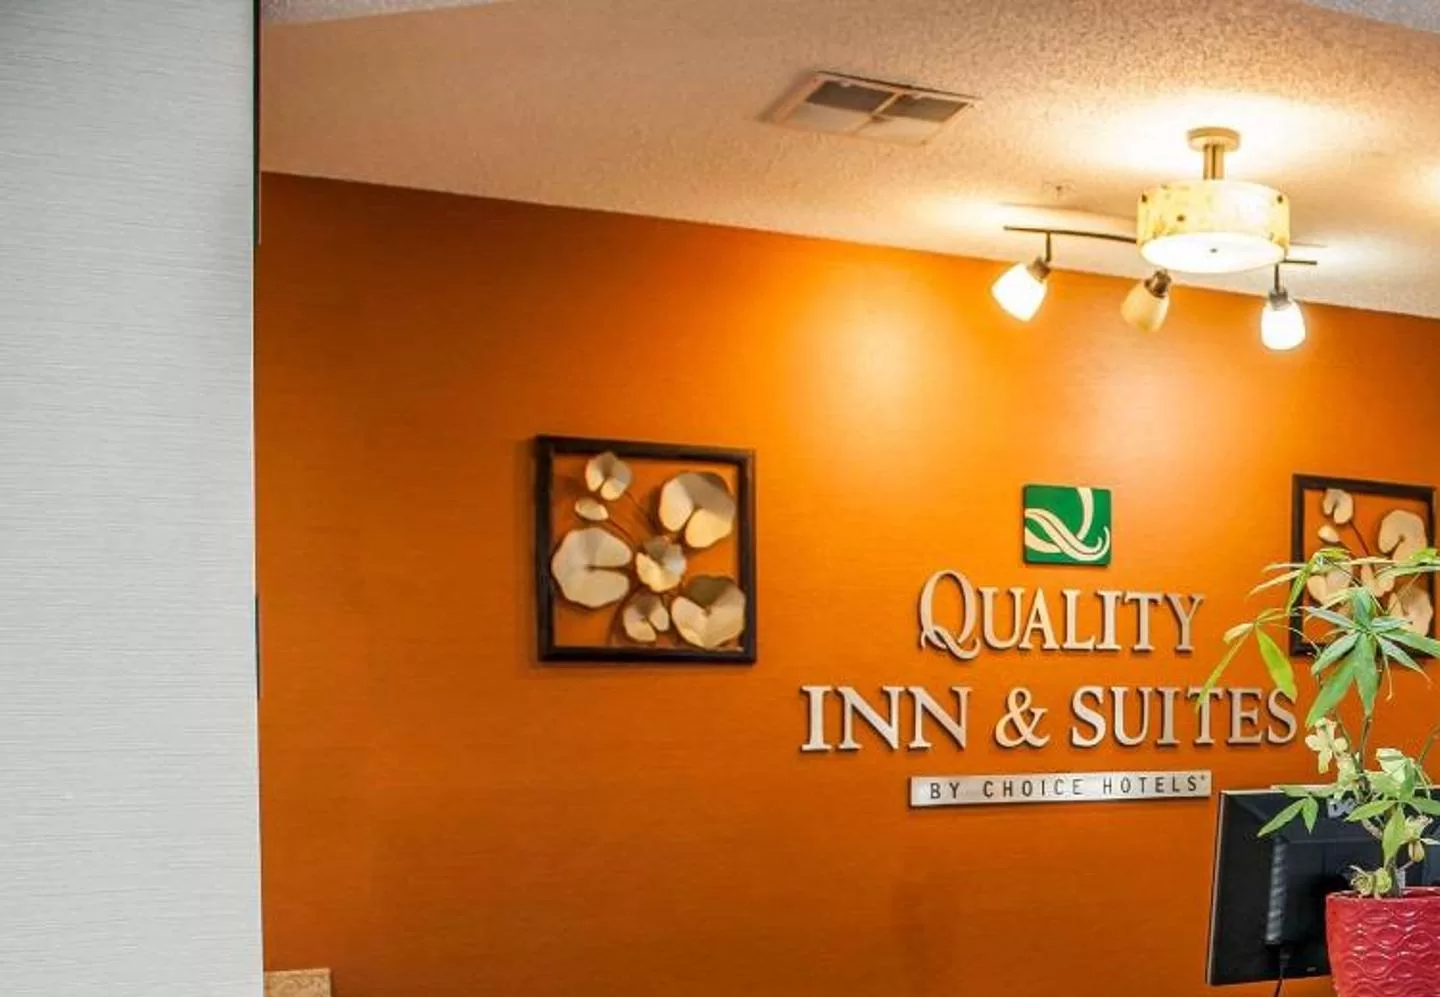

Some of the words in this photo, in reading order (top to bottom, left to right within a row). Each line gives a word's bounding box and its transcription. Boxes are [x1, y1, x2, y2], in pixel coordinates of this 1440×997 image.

[801, 685, 970, 751] INN
[994, 687, 1051, 749] &
[1070, 686, 1298, 748] SUITES
[929, 782, 961, 799] BY
[982, 778, 1084, 799] CHOICE
